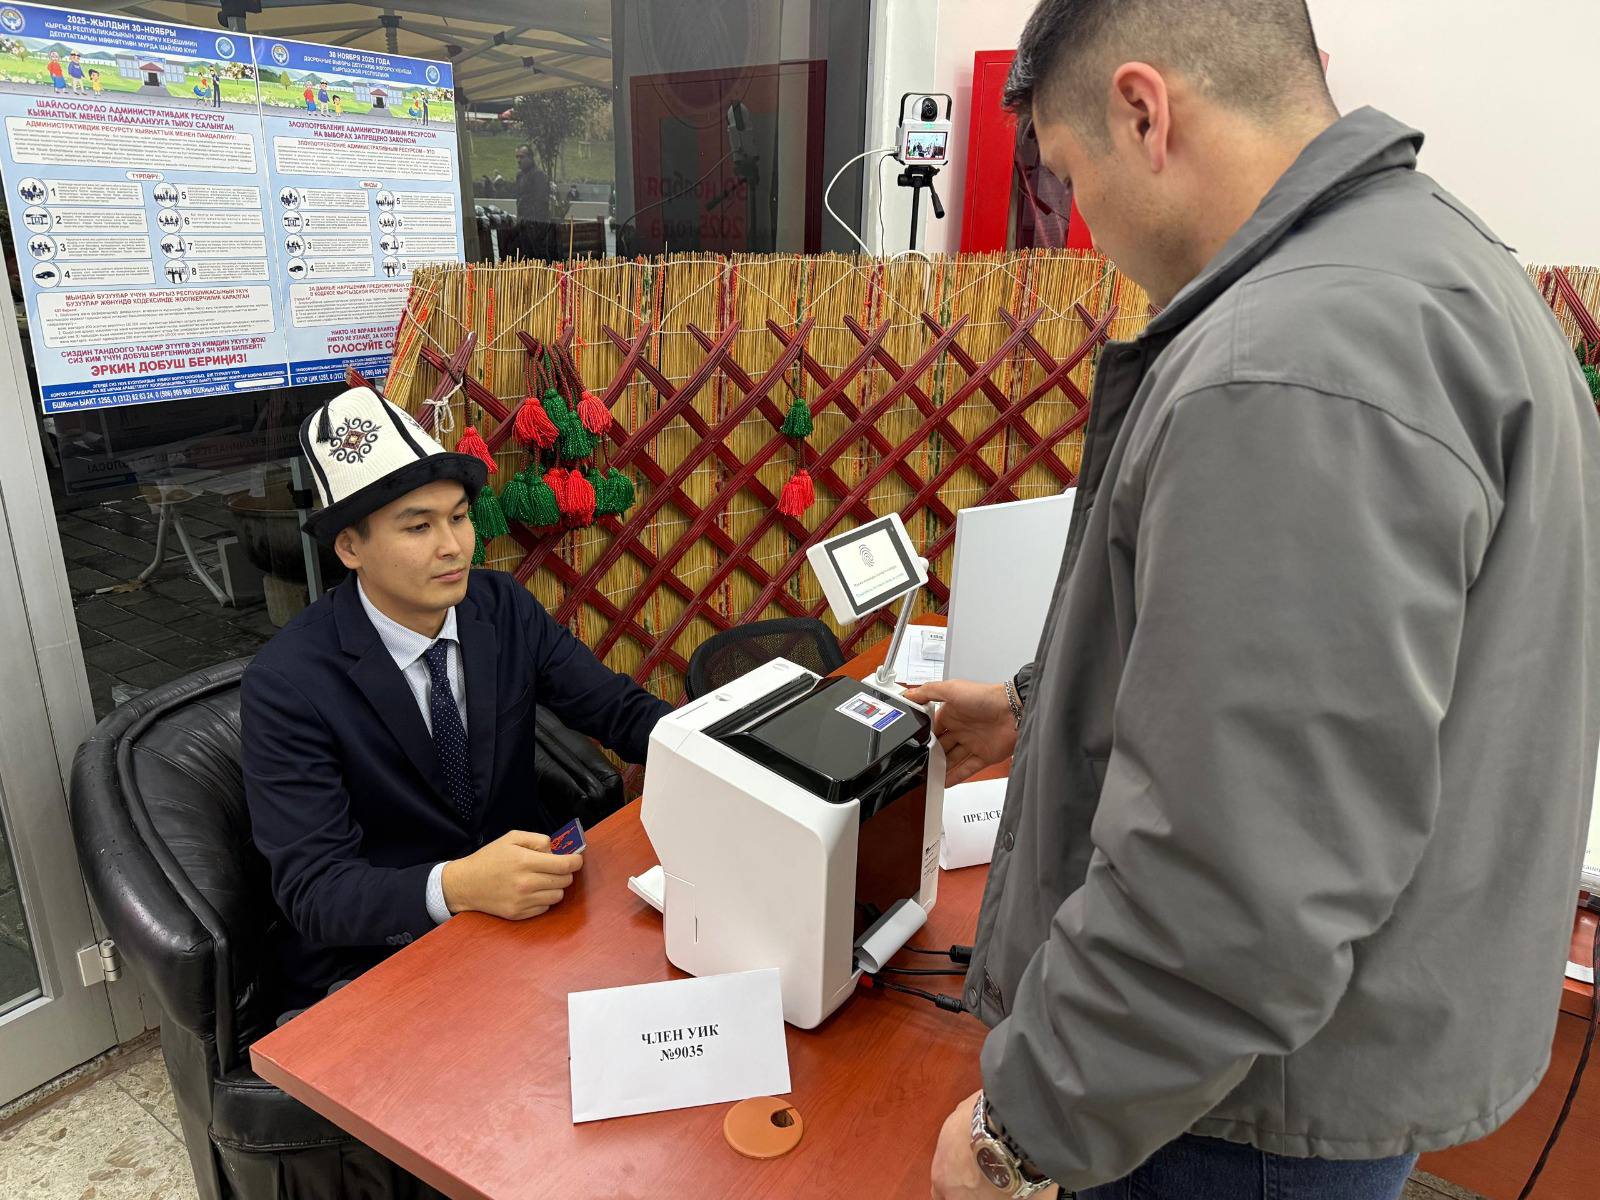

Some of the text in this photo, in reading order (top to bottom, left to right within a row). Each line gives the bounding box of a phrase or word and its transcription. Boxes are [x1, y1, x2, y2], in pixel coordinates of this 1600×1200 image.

[45, 22, 72, 30] КЫРГЫЗ
[67, 15, 177, 37] 2025-ЖЫЛДЫН 30-НОЯБРЫ
[50, 31, 97, 42] ДЕПУТАТТАРЫН
[337, 52, 360, 61] НОЯБРЯ
[362, 55, 374, 63] 2025
[36, 100, 224, 121] ШАЙЛООЛОРДО АДМИНИСТРАТИВДИК РЕСУРСТУ
[28, 108, 234, 131] КЫЯНАТТЫК МЕНЕН ПАЙДАЛАНУУГА ТЫЮУ САЛЫНГАН
[26, 120, 100, 131] АДМИНИСТРАТИВДИК
[135, 128, 174, 136] КЫЯНАТТЫК
[288, 121, 345, 131] ЗЛОУПОТРЕБЛЕНИЕ
[346, 126, 407, 136] АДМИНИСТРАТИВНЫМ
[325, 131, 352, 139] ВЫБОРАХ
[354, 134, 388, 142] ЗАПРЕЩЕНО
[388, 136, 416, 144] ЗАКОНОМ
[51, 188, 56, 196] 1
[182, 192, 186, 200] 5
[56, 216, 62, 224] 2
[185, 217, 189, 225] 6
[60, 243, 66, 251] 3
[64, 270, 71, 279] 4
[192, 268, 196, 276] 8
[61, 349, 92, 358] СИЗДИН
[94, 346, 134, 355] ТАНДООГО
[136, 344, 163, 352] ТААСИР
[166, 342, 190, 350] ЭТҮҮГӨ
[123, 352, 149, 360] ДОБУШ
[151, 348, 204, 358] БЕРГЕНИҢИЗДИ
[232, 343, 263, 351] БИЛБЕЙТ!
[328, 340, 383, 354] ГОЛОСУЙТЕ
[91, 354, 247, 376] ЭРКИН ДОБУШ БЕРИҢИЗ!
[80, 398, 96, 407] ЫАКТ
[117, 394, 132, 402] (312)
[641, 1024, 719, 1045] ЧЛЕН УИК
[660, 1044, 704, 1062] №9035
